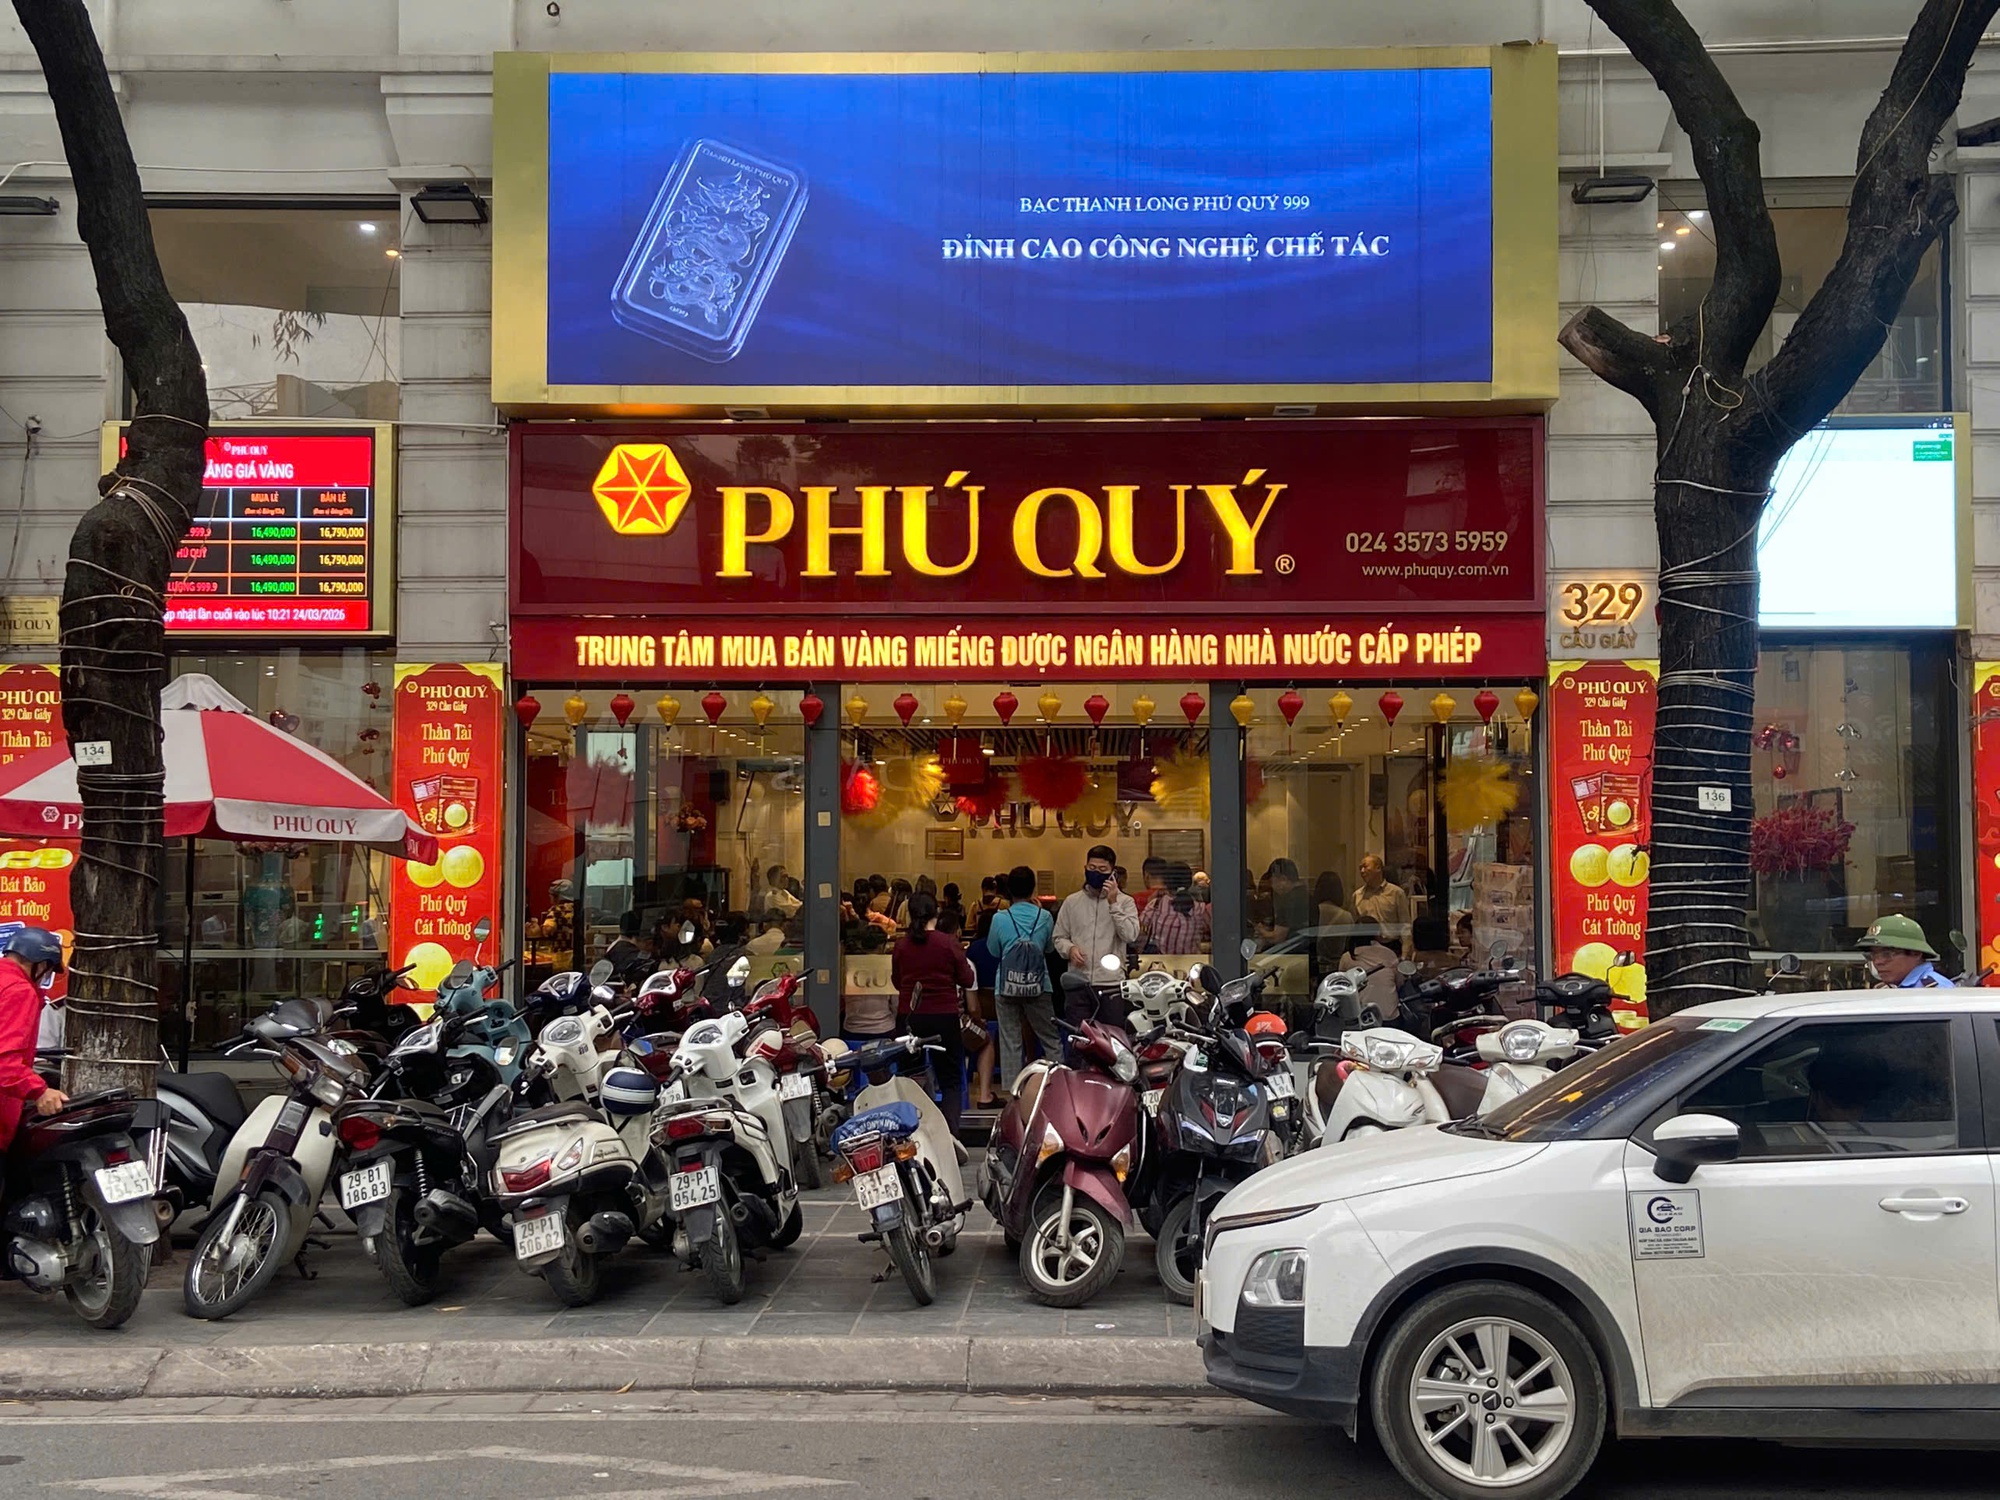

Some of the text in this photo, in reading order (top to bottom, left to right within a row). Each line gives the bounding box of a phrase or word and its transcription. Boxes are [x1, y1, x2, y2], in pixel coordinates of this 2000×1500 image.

[1020, 194, 1310, 214] BẠC THANH LONG PHÚ QUÝ 999
[942, 230, 1390, 262] ĐỈNH CAO CÔNG NGHỆ CHẾ TÁC
[204, 459, 294, 478] ẢNG GIÁ VÀNG
[715, 468, 1288, 578] PHÚ QUÝ
[251, 527, 296, 538] 16,490,000
[319, 527, 364, 538] 16,790,000
[1346, 530, 1508, 553] 024 3573 5959
[251, 554, 296, 565] 16,490,000
[319, 554, 364, 565] 16,790,000
[1362, 562, 1509, 580] www.phuquy.com.vn
[250, 581, 295, 592] 16,490,000
[318, 581, 364, 592] 16,790,000
[1562, 582, 1643, 621] 329
[268, 609, 291, 620] 10:21
[292, 608, 345, 621] 24/03/2026
[576, 622, 1481, 673] TRUNG TÂM MUA BÁN VÀNG MIẾNG ĐƯỢC NGÂN HÀNG NHÀ NƯỚC CẤP PHÉP
[420, 684, 487, 699] PHÚ QUÝ
[1578, 680, 1647, 694] PHÚ QUÝ
[36, 690, 61, 705] QU
[426, 701, 438, 711] 329
[1584, 697, 1596, 708] 329
[2, 708, 15, 720] 329
[421, 723, 472, 740] Thần Tài
[1580, 719, 1632, 737] Thần Tài
[1, 730, 52, 748] Thần Tài
[82, 746, 104, 755] 134
[423, 747, 470, 769] Phú Quý
[1583, 744, 1631, 765] Phú Quý
[1705, 791, 1725, 801] 136
[273, 812, 314, 832] PHÚ
[1, 876, 46, 893] Bát Bảo
[0, 899, 51, 921] át Tường
[420, 894, 468, 916] Phú Quý
[1587, 894, 1636, 916] Phú Quý
[415, 918, 472, 940] Cát Tường
[1582, 918, 1641, 940] Cát Tường
[1008, 970, 1026, 983] ONE
[348, 1167, 380, 1189] 29-B1
[676, 1170, 709, 1190] 29-P1
[347, 1181, 387, 1205] 186.83
[674, 1184, 716, 1207] 954.25
[521, 1216, 553, 1239] 29-P1
[519, 1231, 560, 1255] 506.82
